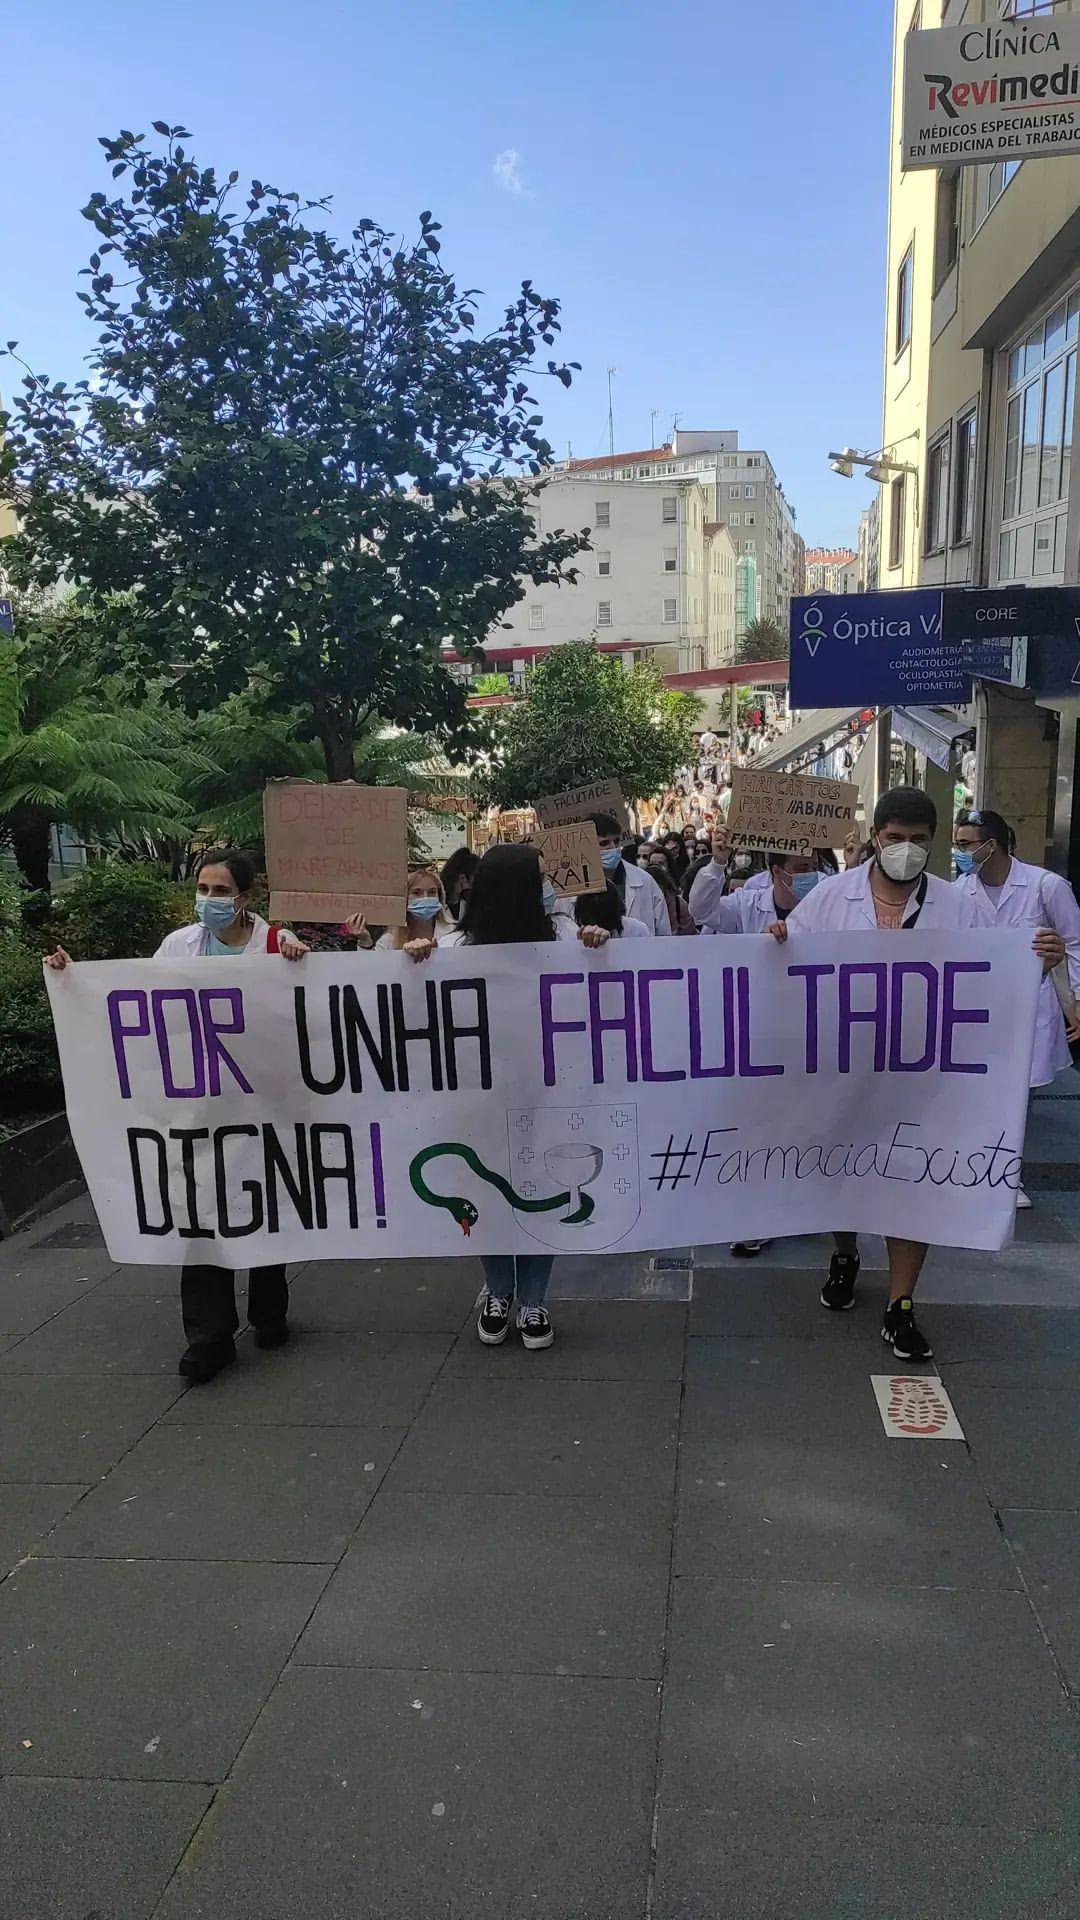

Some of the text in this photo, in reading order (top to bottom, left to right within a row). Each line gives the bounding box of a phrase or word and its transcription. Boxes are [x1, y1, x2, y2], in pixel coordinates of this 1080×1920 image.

[919, 112, 1075, 140] MÉDICOS ESPECIALISTAS
[910, 145, 926, 157] EN
[930, 138, 994, 154] MEDICINA
[998, 135, 1021, 148] DEL
[975, 607, 1017, 621] CORE
[833, 612, 911, 645] Óptica
[554, 783, 611, 810] FACULTADE
[730, 833, 810, 855] FARMACIA?
[107, 961, 991, 1099] POR UNHA FACULTADE
[127, 1122, 1023, 1239] DIGNA! #FarmaciaExiste
